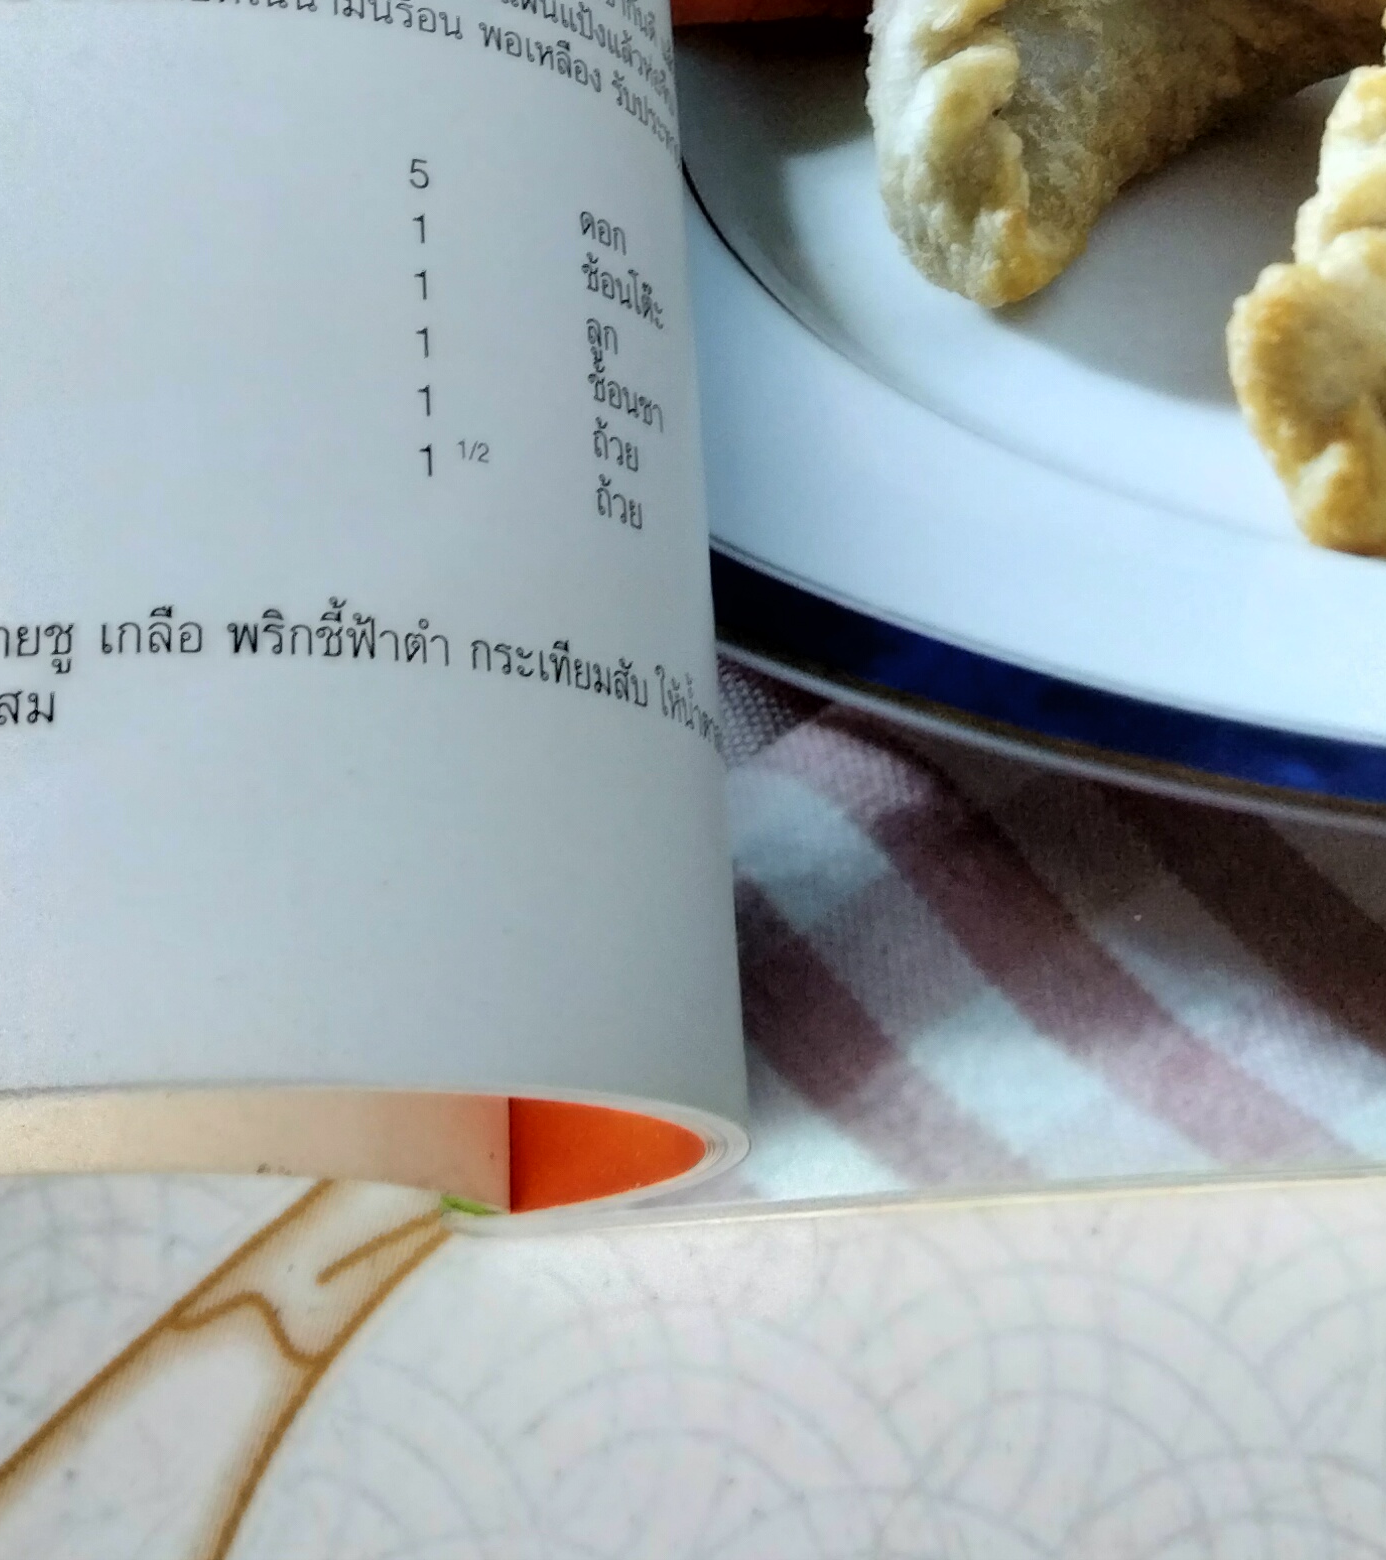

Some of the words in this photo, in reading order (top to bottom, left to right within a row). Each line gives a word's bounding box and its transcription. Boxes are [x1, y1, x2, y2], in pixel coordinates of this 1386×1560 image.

[479, 21, 602, 93] พอเหลือง
[409, 158, 430, 190] 5
[579, 210, 628, 256] ดอก
[412, 213, 426, 244] 1
[414, 269, 428, 300] 1
[415, 327, 429, 358] 1
[417, 384, 431, 417] 1
[592, 416, 639, 472] ถ้วย
[419, 443, 433, 477] 1
[456, 438, 491, 464] 1/2
[596, 473, 643, 530] ถ้วย
[99, 606, 205, 657] เกลือ
[469, 637, 650, 709] กระเทียมสับ
